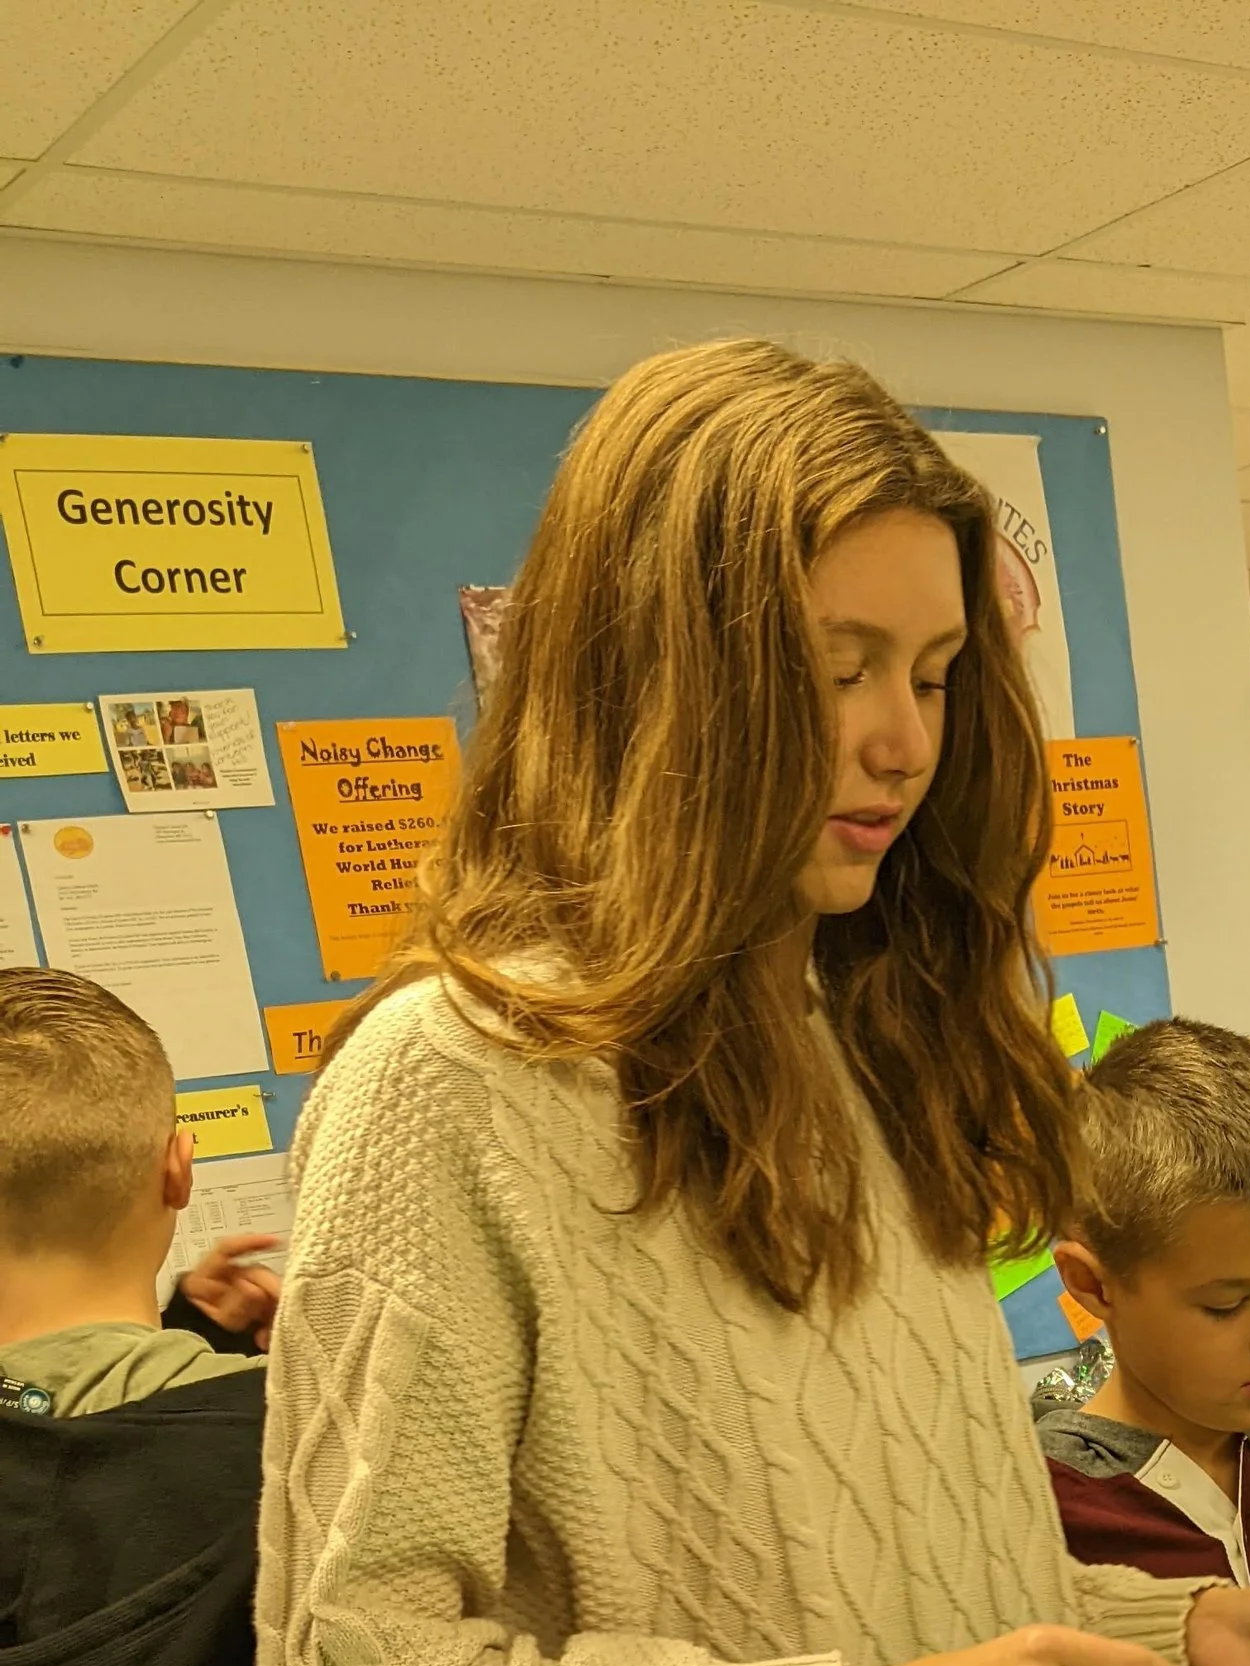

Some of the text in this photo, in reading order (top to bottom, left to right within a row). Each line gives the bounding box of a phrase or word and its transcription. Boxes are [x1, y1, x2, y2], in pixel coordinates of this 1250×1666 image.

[57, 488, 273, 535] Generosity
[998, 497, 1048, 565] ITES
[113, 559, 247, 594] Corner
[4, 729, 81, 743] letters we
[0, 752, 36, 767] eived
[301, 736, 444, 767] Noisy Change
[1062, 753, 1092, 767] The
[337, 776, 423, 801] Offering
[1052, 778, 1119, 792] hristmas
[1062, 802, 1105, 816] Story
[312, 817, 441, 835] We raised $260.
[338, 842, 363, 853] for
[336, 860, 387, 874] World
[348, 901, 401, 916] Thank
[292, 1029, 322, 1053] Th
[176, 1104, 249, 1124] reasurer's
